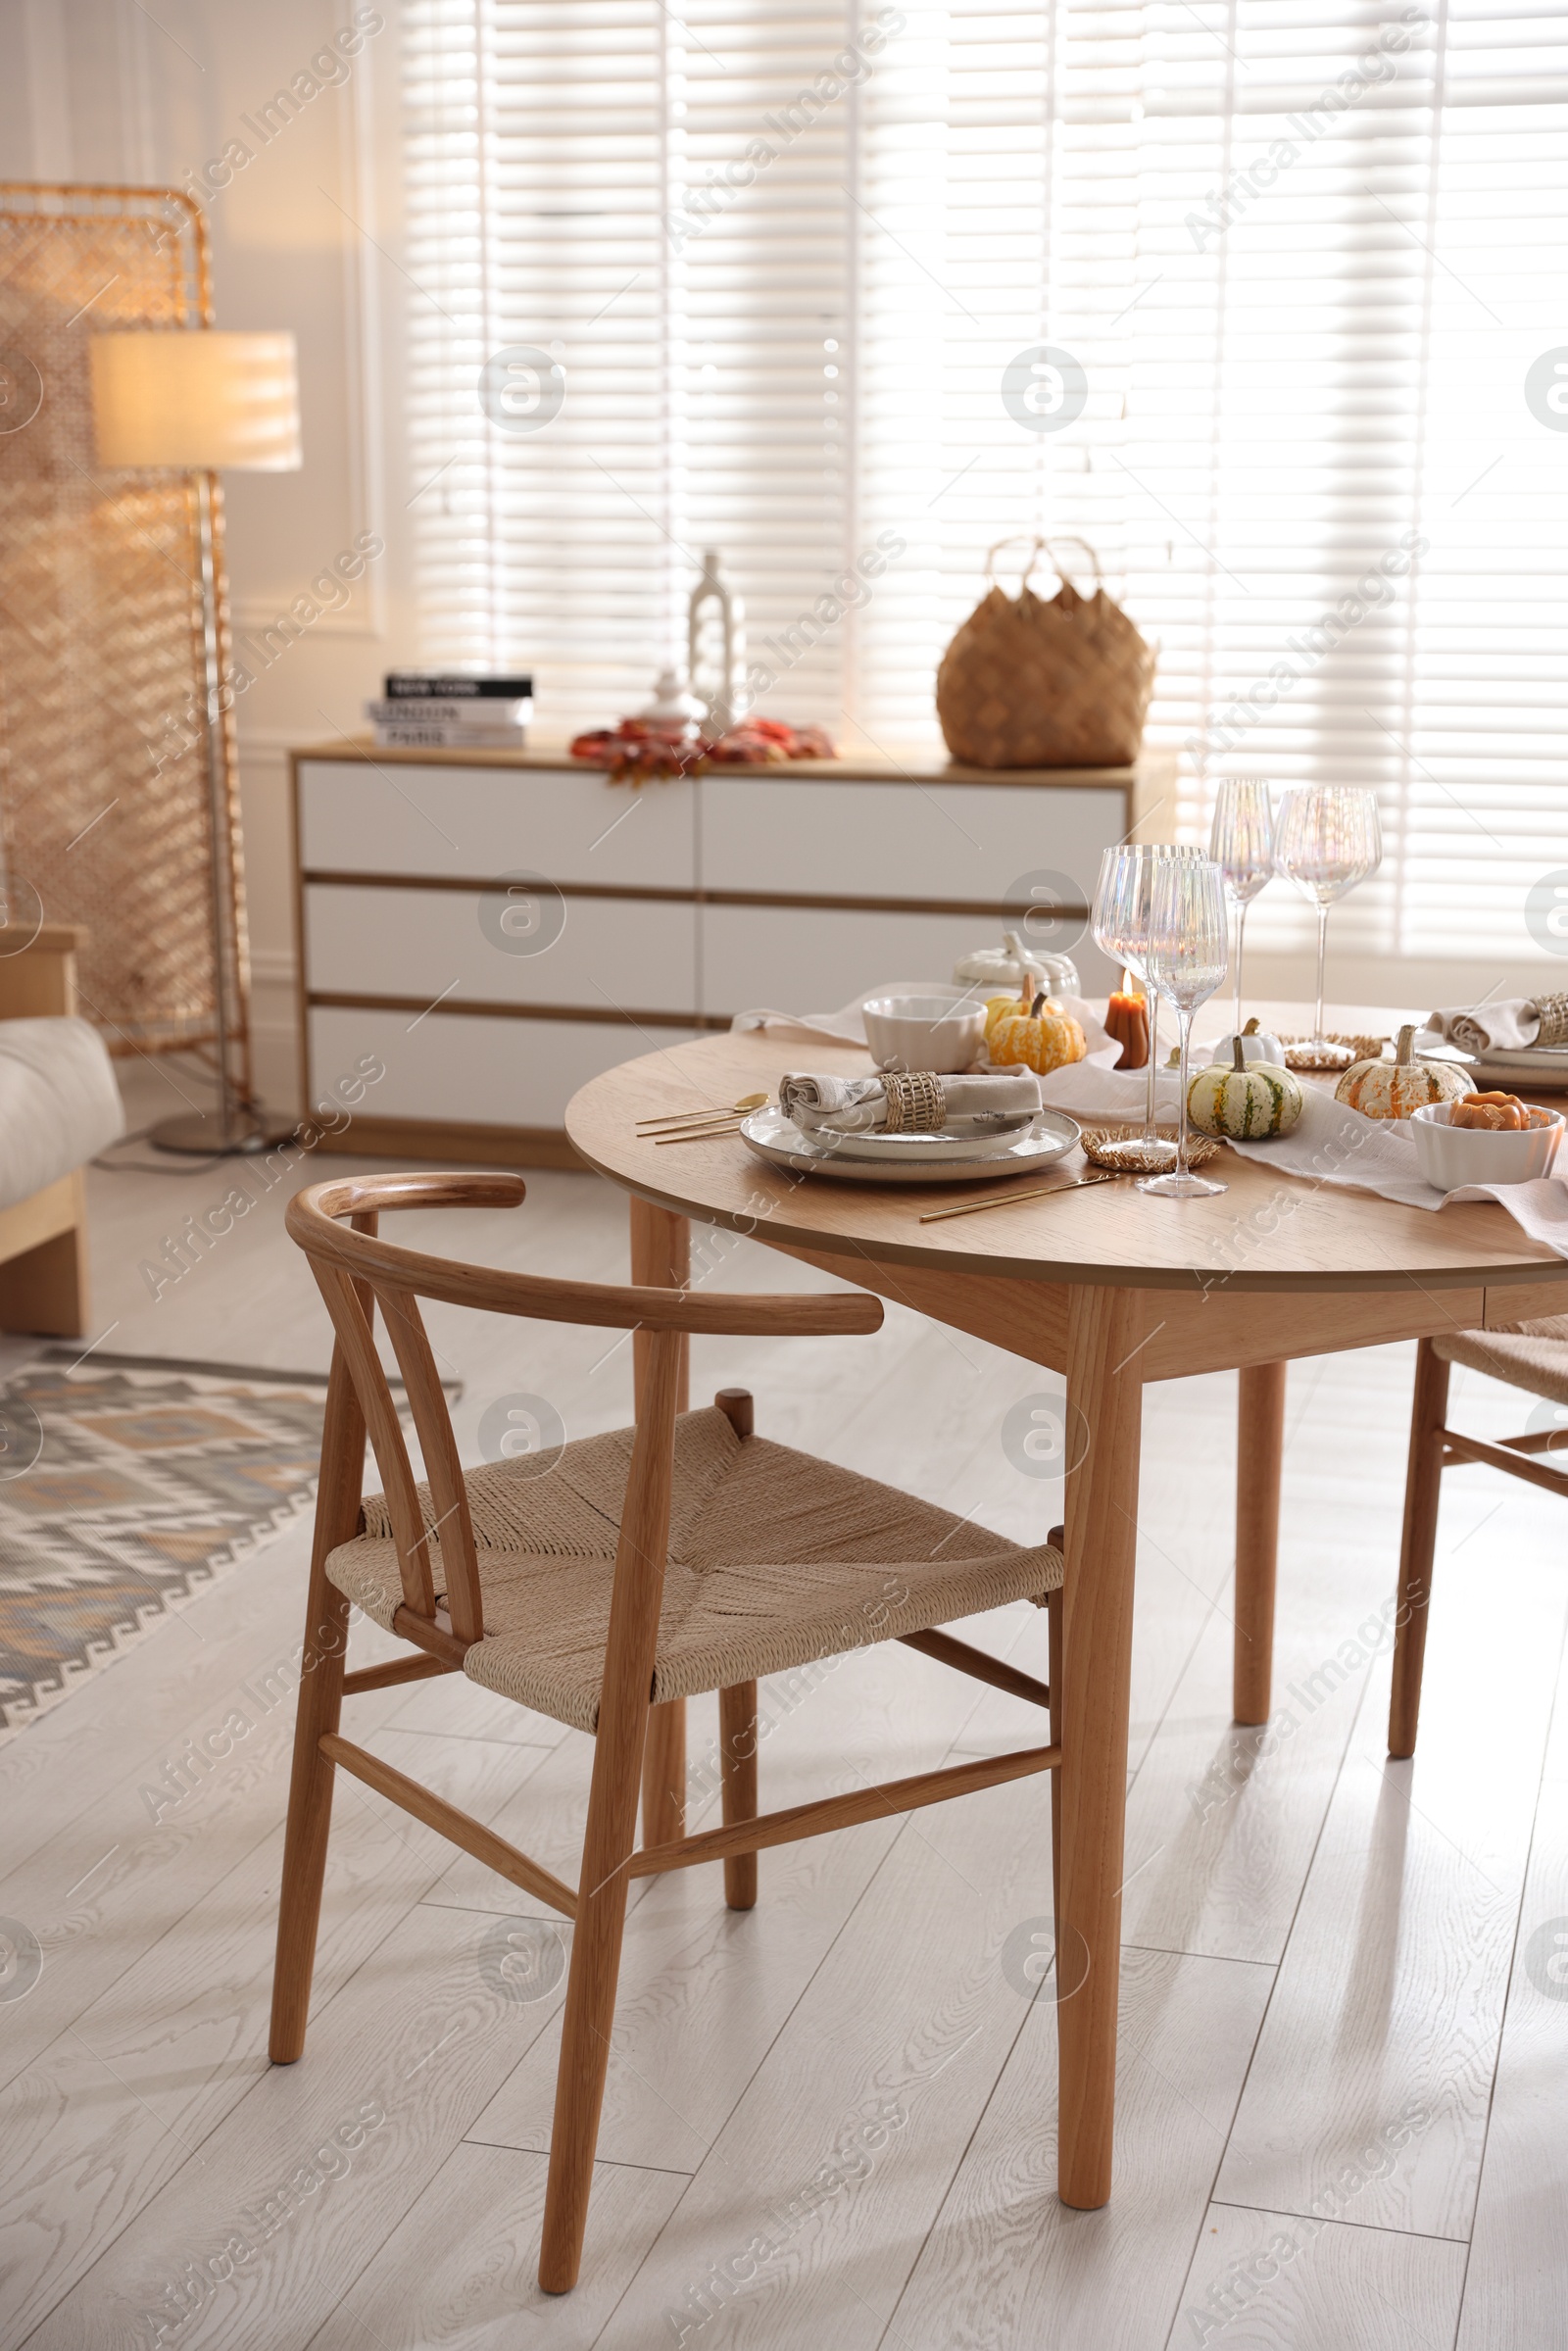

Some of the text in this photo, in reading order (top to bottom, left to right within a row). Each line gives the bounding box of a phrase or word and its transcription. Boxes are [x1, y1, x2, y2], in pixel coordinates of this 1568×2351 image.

[392, 682, 480, 697] NEW YORK
[369, 703, 461, 722] LONDON
[387, 725, 445, 747] PARIS
